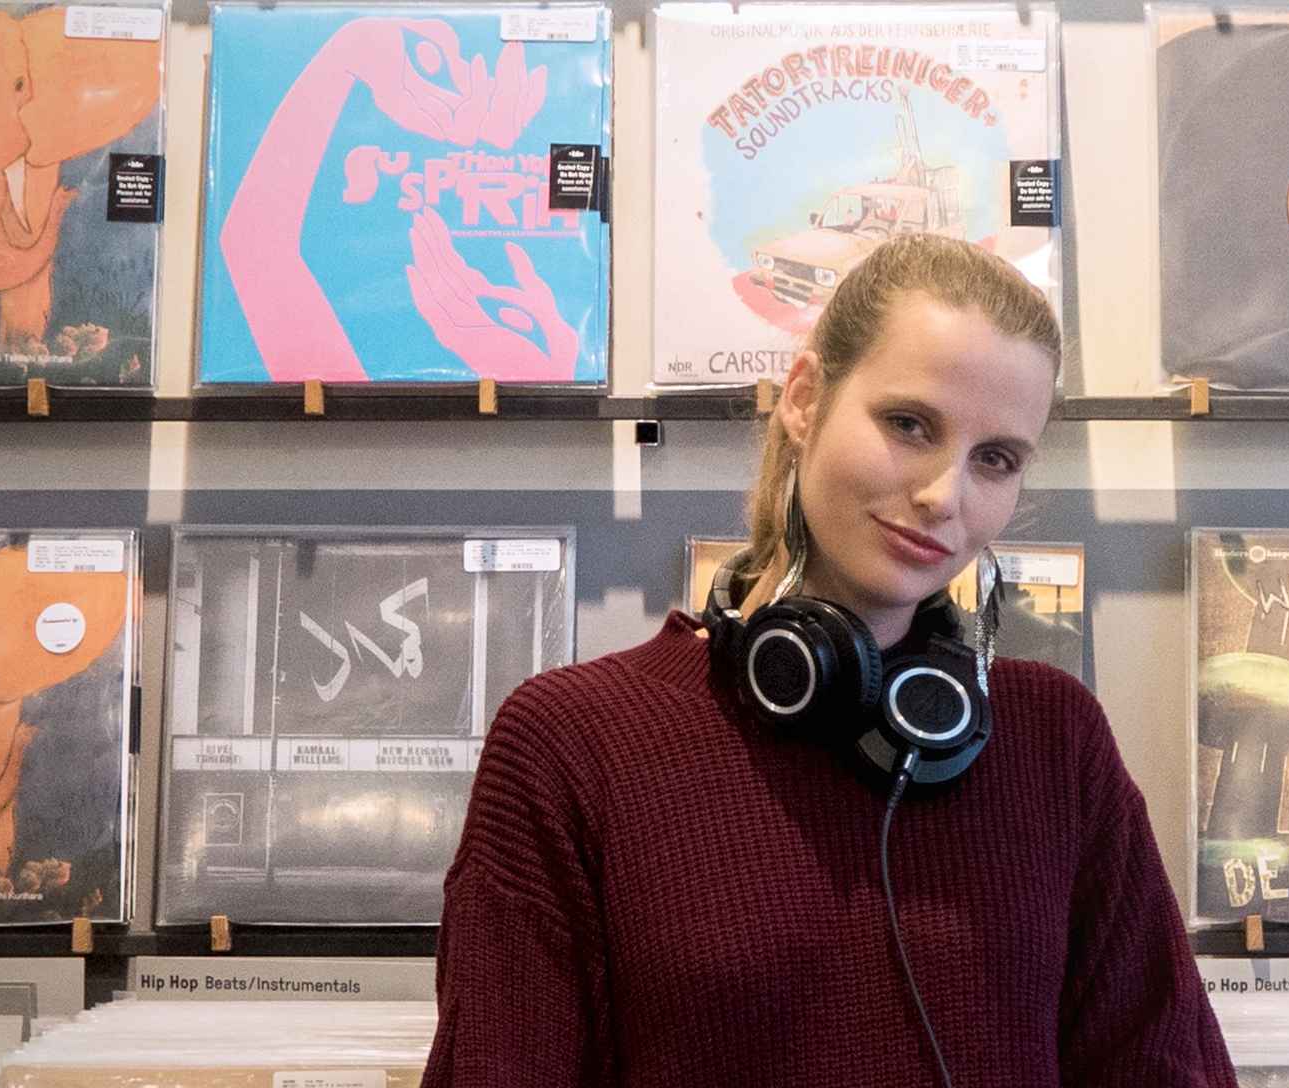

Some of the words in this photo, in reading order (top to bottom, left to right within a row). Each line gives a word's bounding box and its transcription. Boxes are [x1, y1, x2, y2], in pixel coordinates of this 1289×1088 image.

[735, 78, 894, 160] SOUNDTRACKS
[140, 974, 166, 993] Hip
[169, 975, 199, 993] Hop
[205, 975, 361, 995] Beats/Instrumentals
[1220, 978, 1249, 994] Hop
